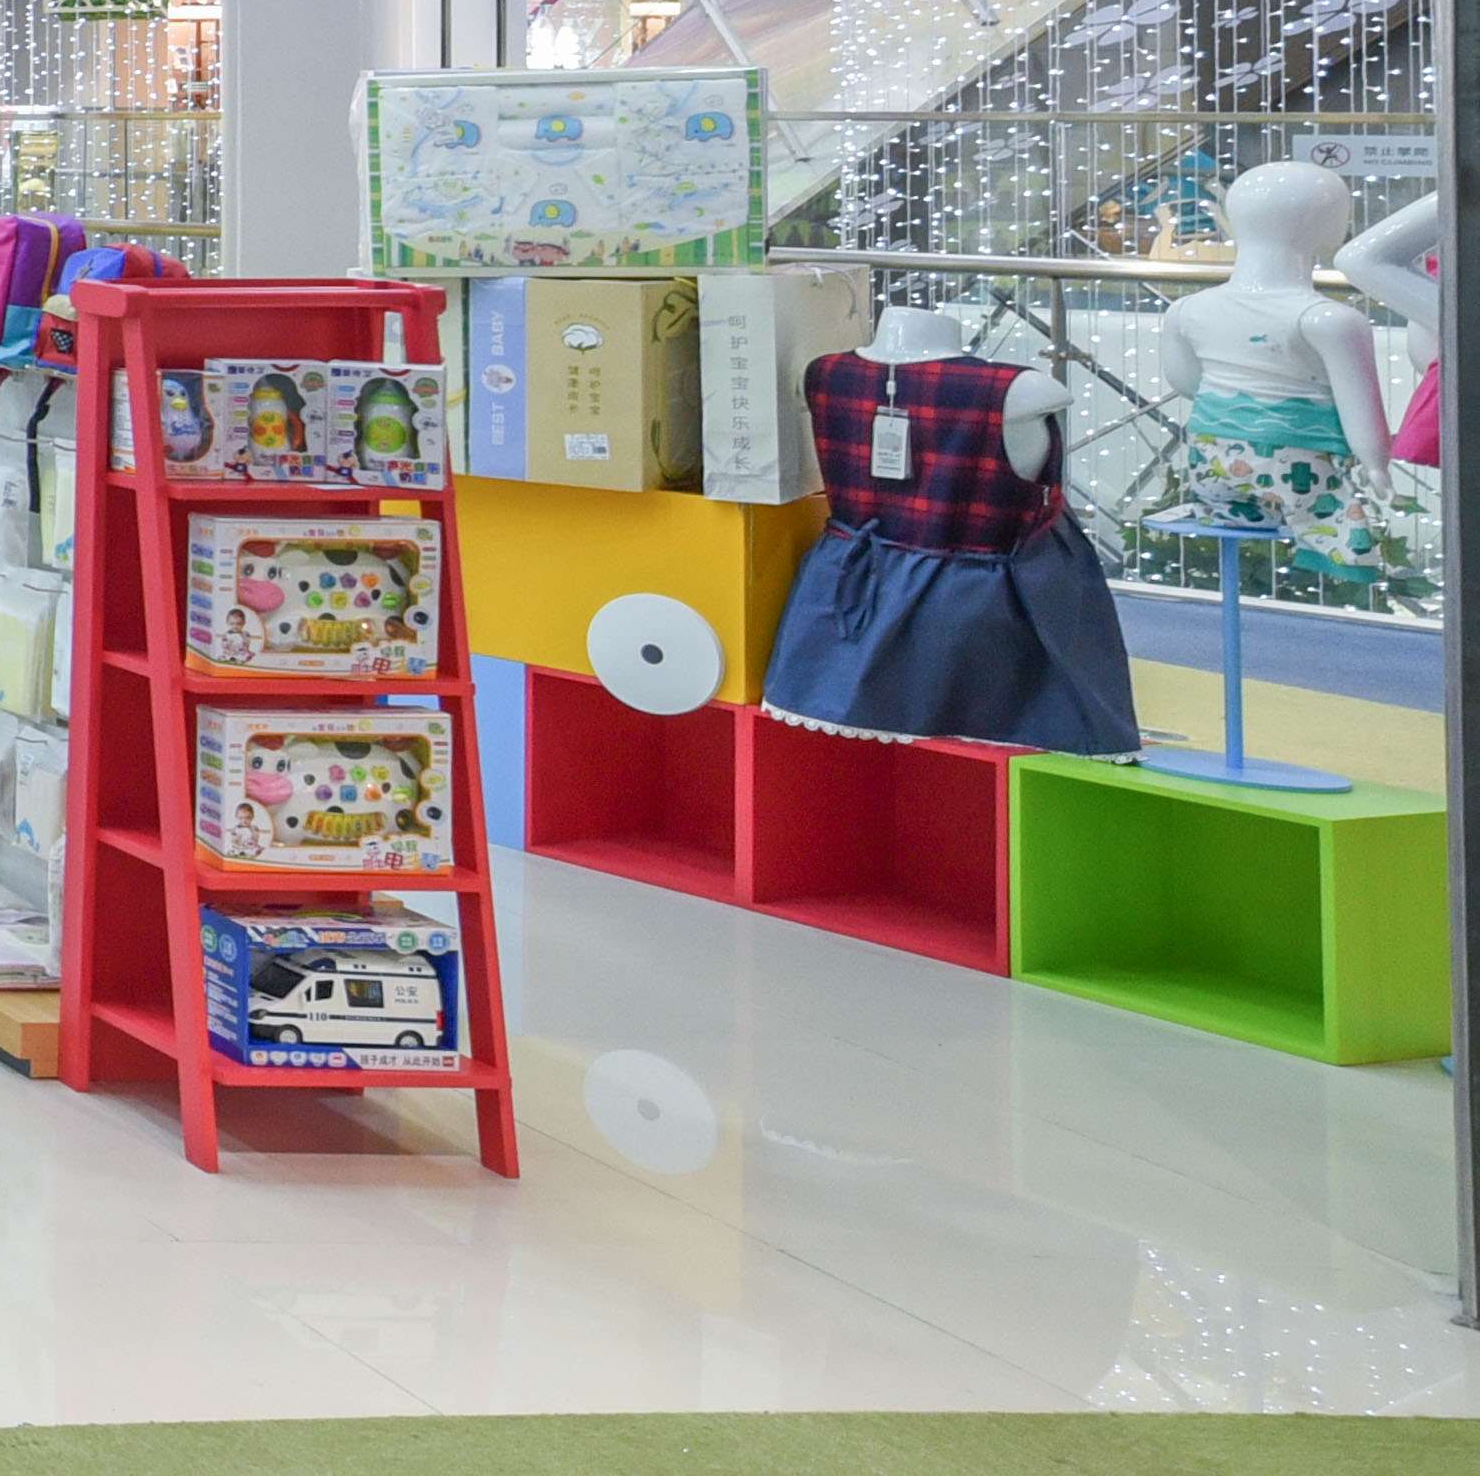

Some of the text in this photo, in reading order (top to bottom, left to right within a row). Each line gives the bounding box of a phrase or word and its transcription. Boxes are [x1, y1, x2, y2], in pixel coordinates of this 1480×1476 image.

[490, 310, 505, 446] BEST BABY
[728, 314, 752, 471] 呵护宝宝快乐成长
[308, 1011, 328, 1022] 110
[394, 985, 419, 997] 公安
